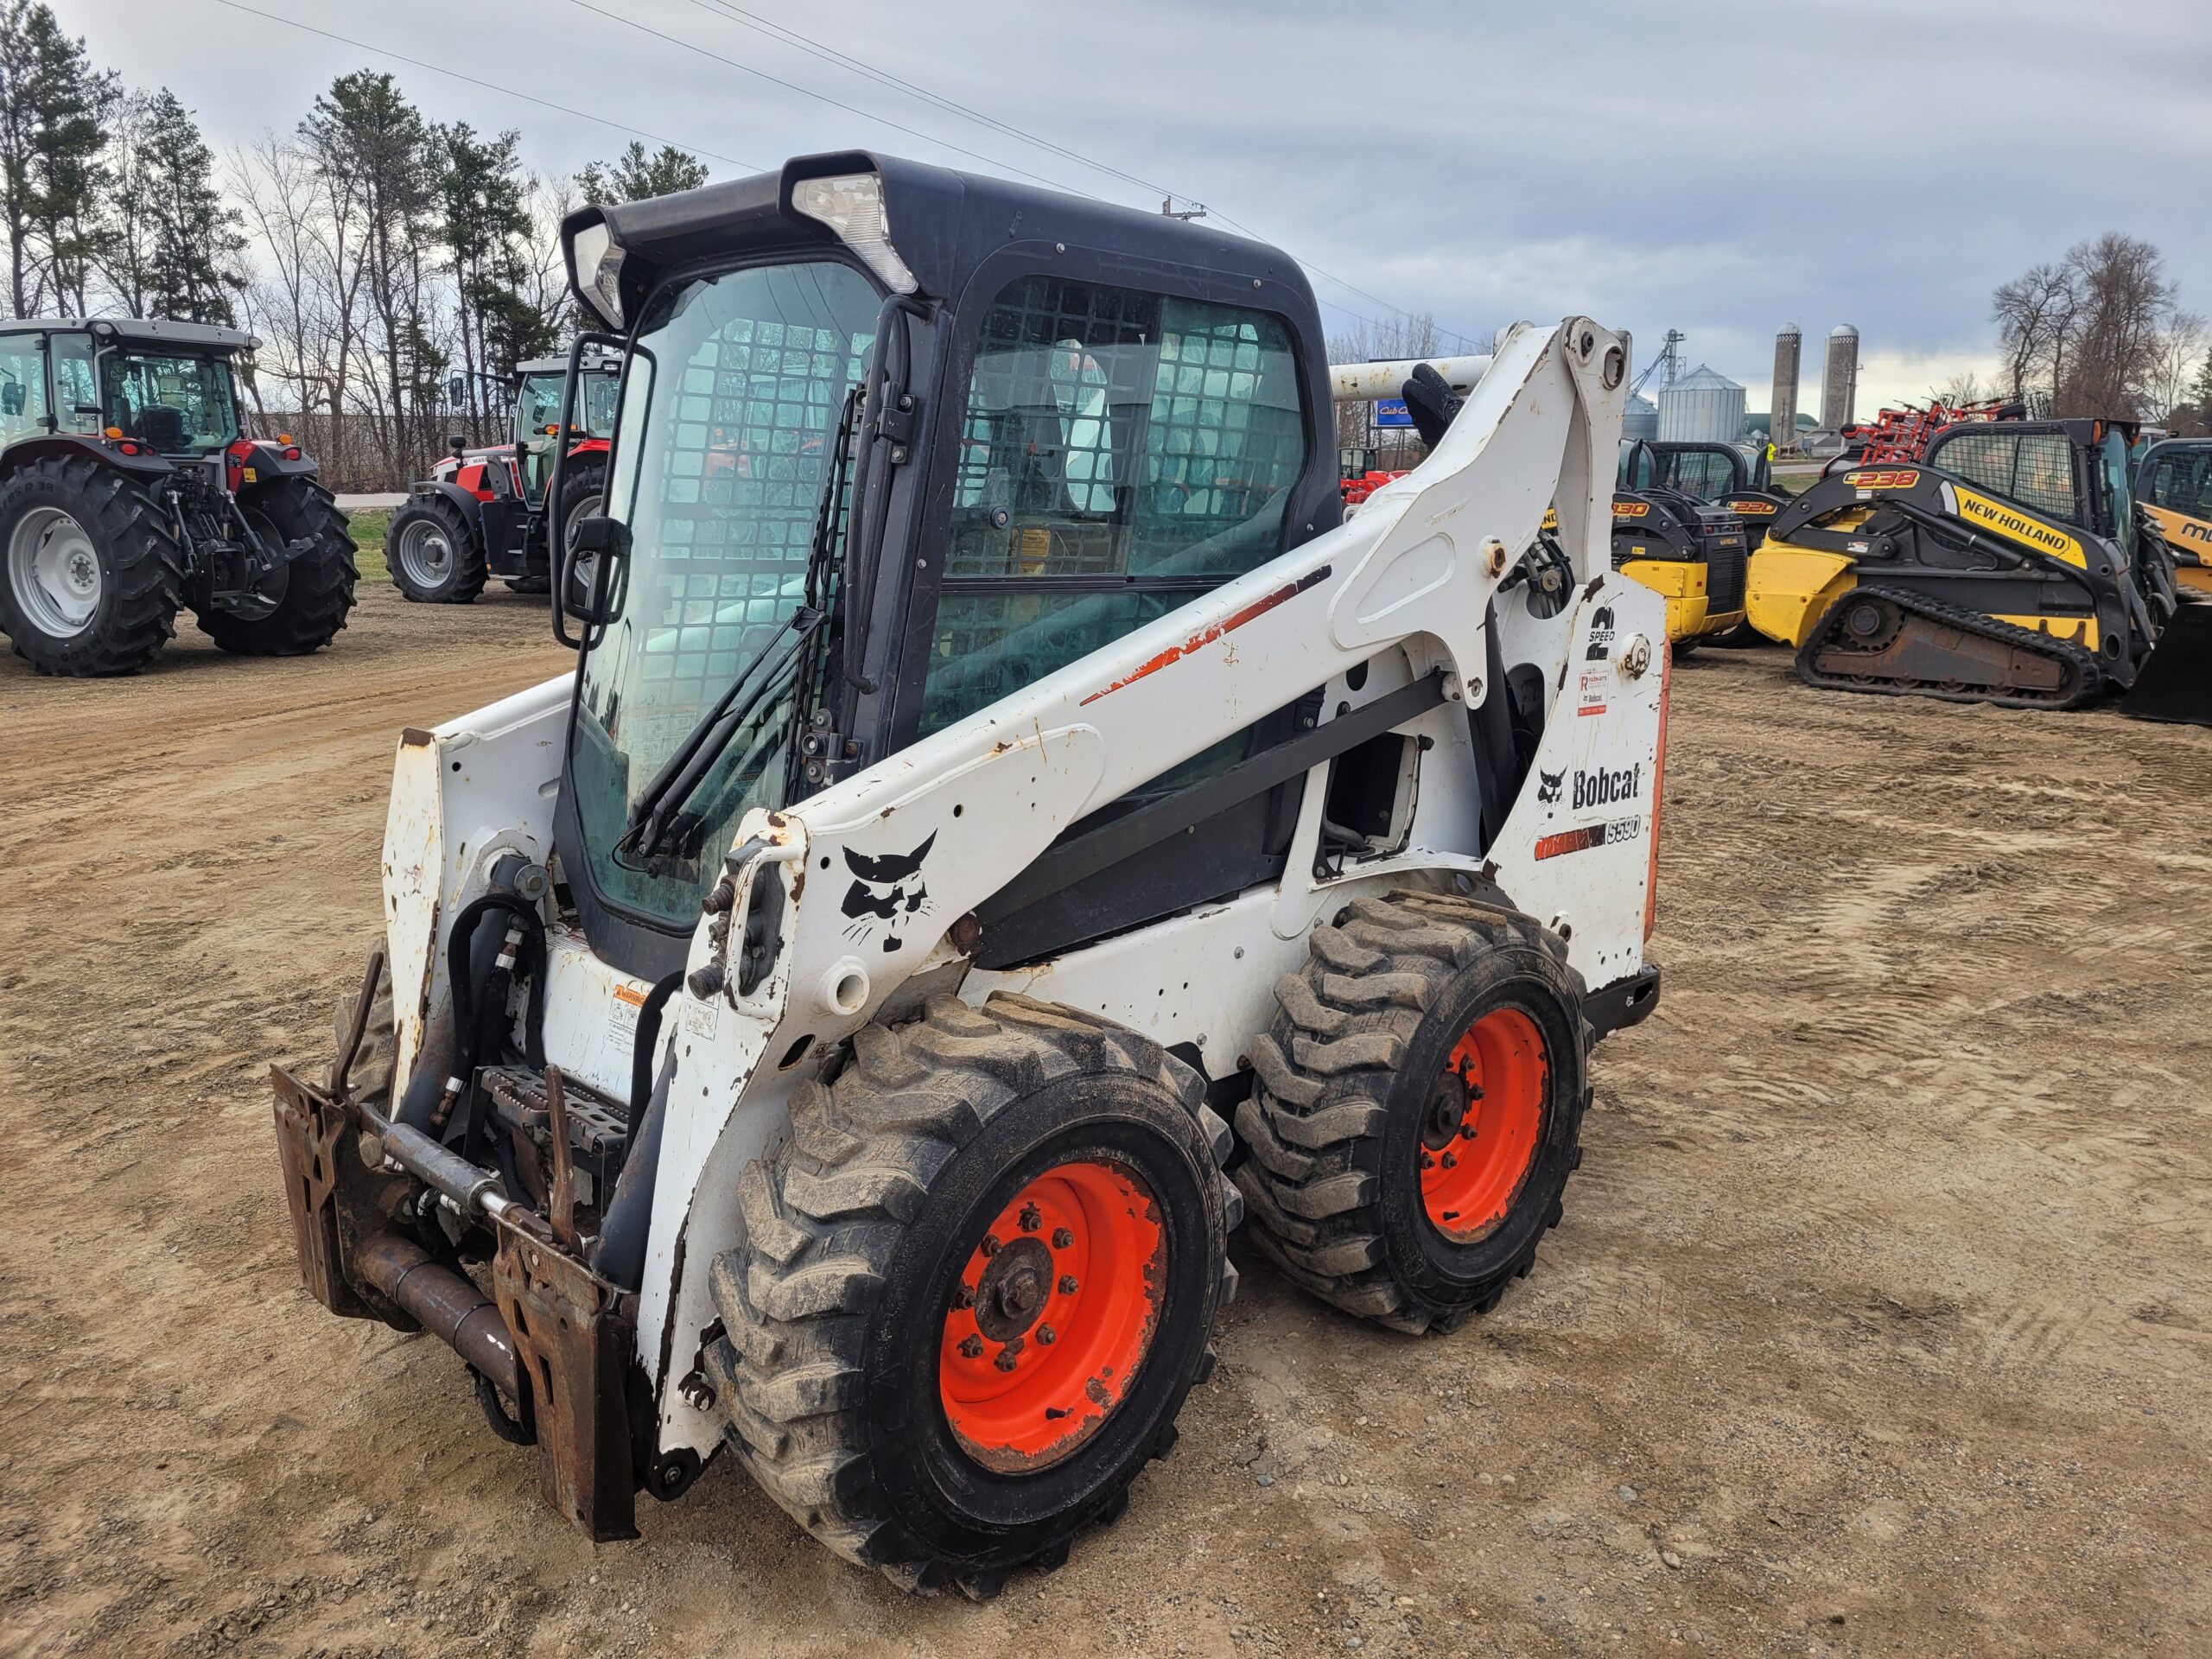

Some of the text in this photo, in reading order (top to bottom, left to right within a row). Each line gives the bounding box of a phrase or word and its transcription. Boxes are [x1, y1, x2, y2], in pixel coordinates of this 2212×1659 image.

[1380, 406, 1397, 415] Cub
[1844, 471, 1919, 488] C238
[1964, 499, 2066, 550] NEW HOLLAND
[1589, 631, 1615, 642] SPEED
[1588, 694, 1603, 703] Bobcat
[1573, 762, 1639, 810] Bobcat
[1607, 817, 1641, 844] S590
